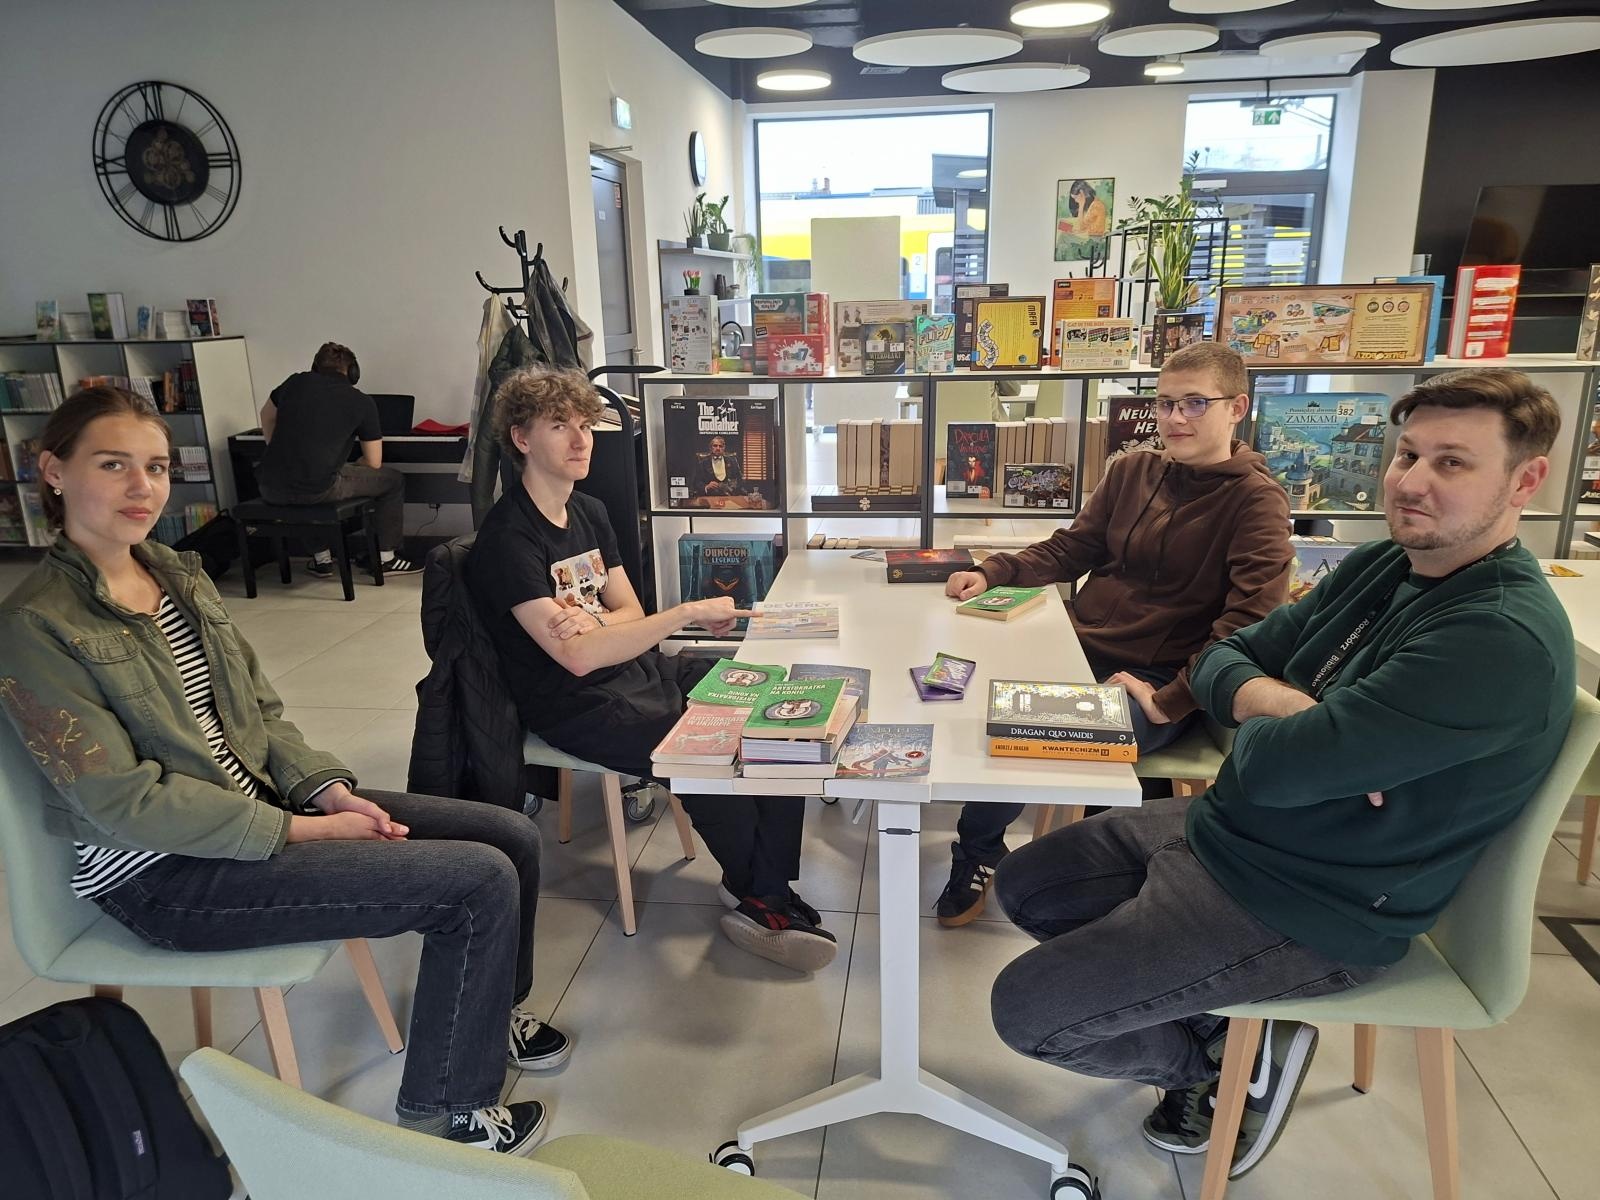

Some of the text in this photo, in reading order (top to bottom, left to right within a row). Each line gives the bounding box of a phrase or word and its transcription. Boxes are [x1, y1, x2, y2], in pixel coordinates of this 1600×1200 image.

[914, 255, 921, 266] 2
[1027, 305, 1038, 326] MAFIA
[697, 402, 714, 416] The
[1337, 408, 1354, 416] 382
[697, 414, 739, 432] Godfather
[1286, 415, 1337, 423] ZAMKAMI
[704, 548, 747, 557] DUNGEON
[1311, 618, 1370, 687] Racibórz Biblioteka
[772, 684, 826, 692] ARYSTOKRATKA
[1010, 727, 1094, 739] DRAGAN QUO VAIDIS
[1042, 745, 1100, 753] KWANTECHIZM
